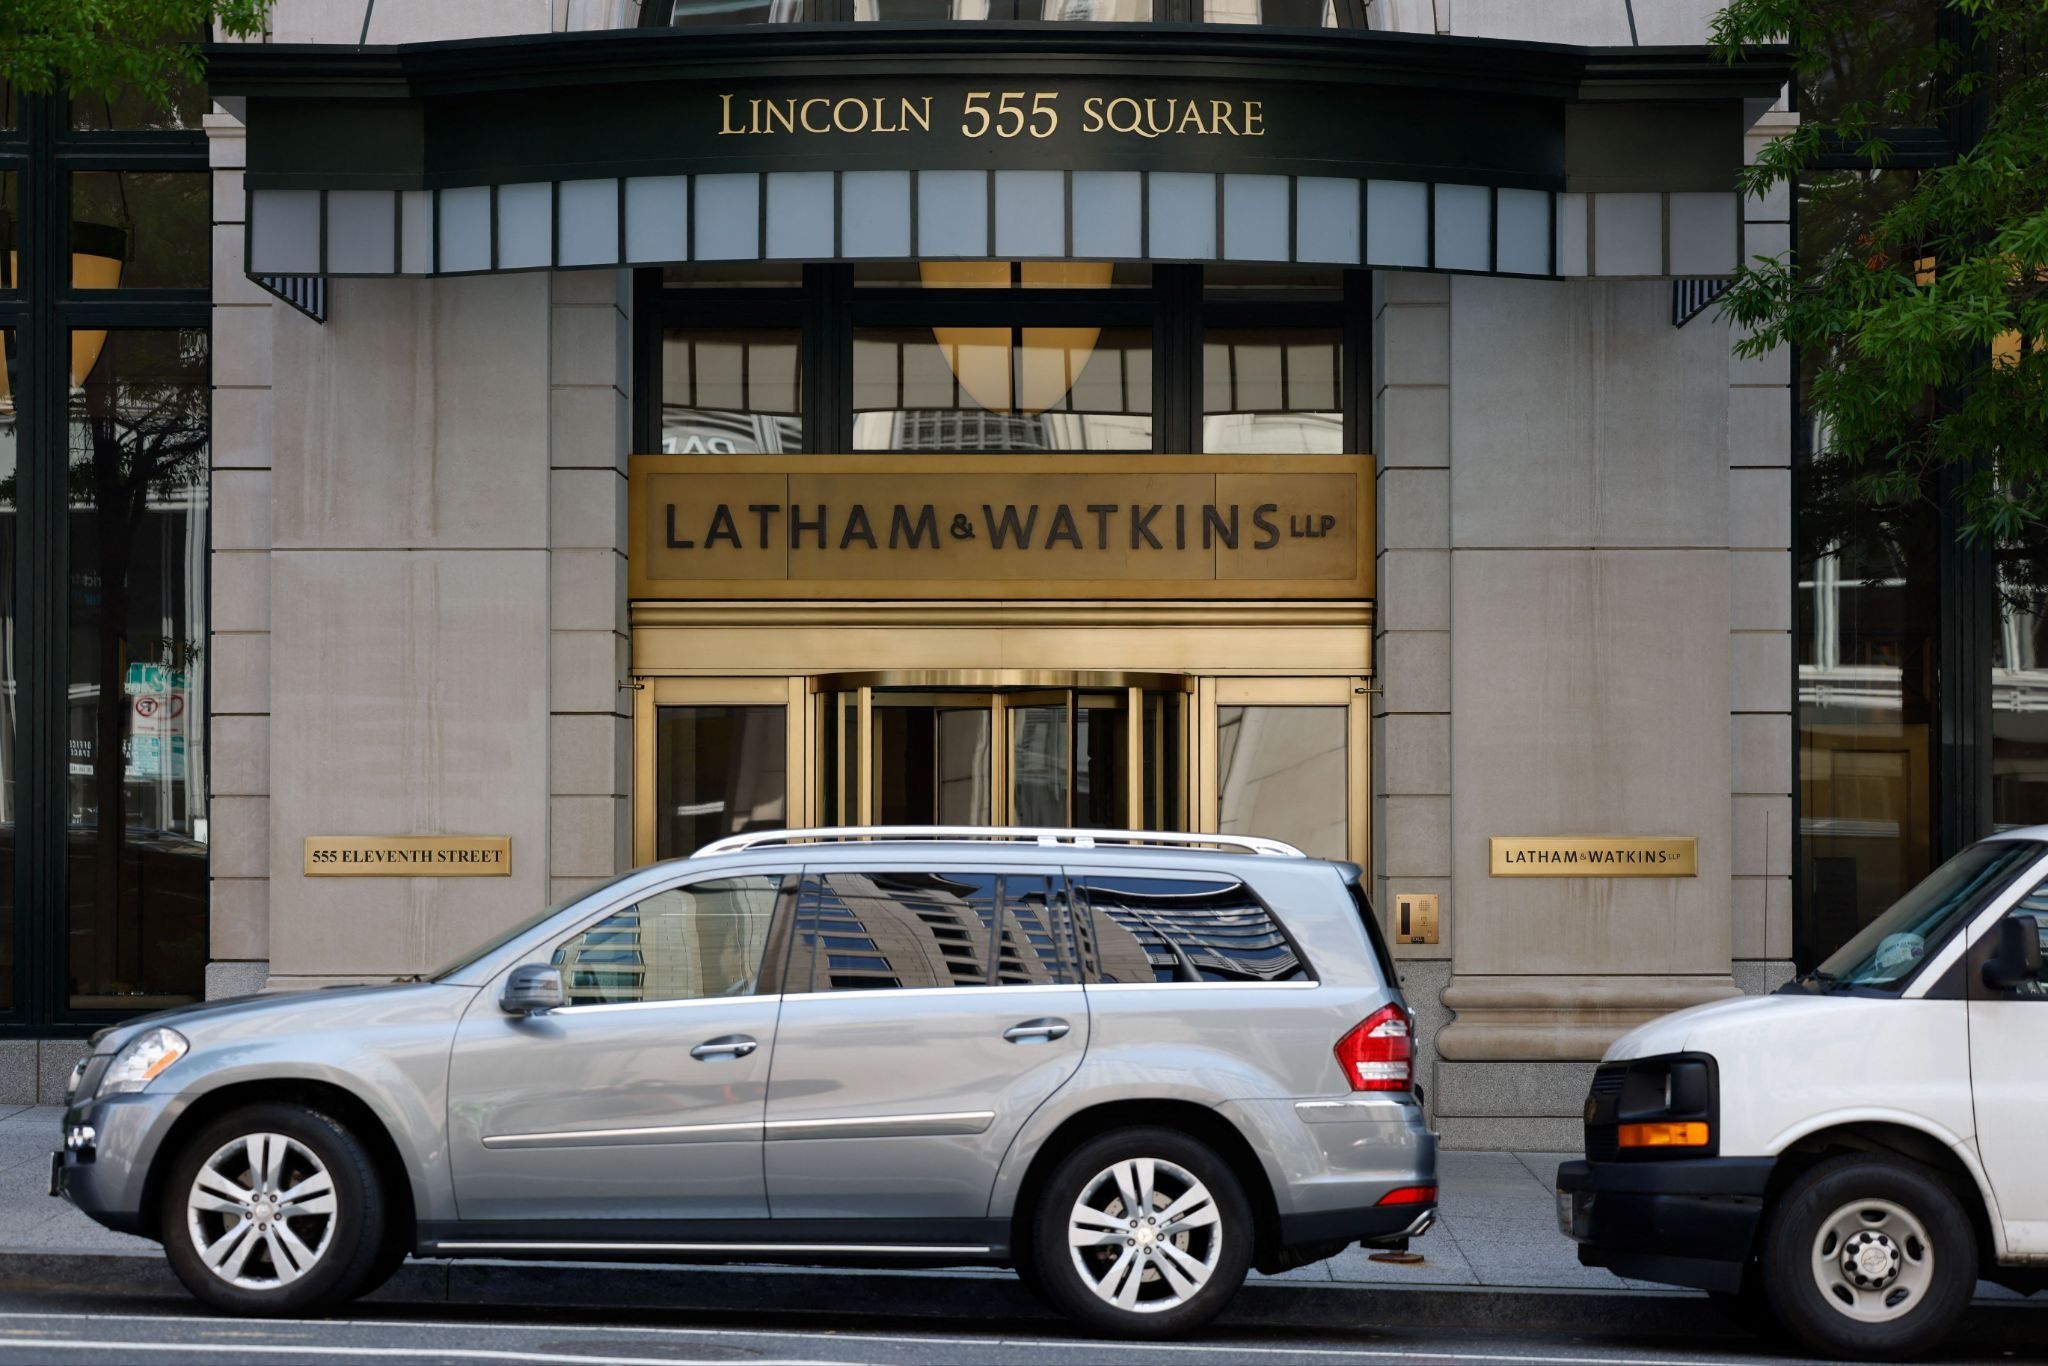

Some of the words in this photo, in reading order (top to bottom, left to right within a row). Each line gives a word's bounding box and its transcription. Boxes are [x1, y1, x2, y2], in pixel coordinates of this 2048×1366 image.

[718, 94, 933, 135] LINCOLN
[961, 91, 1059, 139] 555
[1082, 97, 1265, 138] SQUARE
[1290, 514, 1336, 538] LLP
[312, 850, 338, 863] 555
[341, 850, 433, 863] ELEVENTH
[437, 849, 503, 863] STREET
[1668, 853, 1681, 861] LLP
